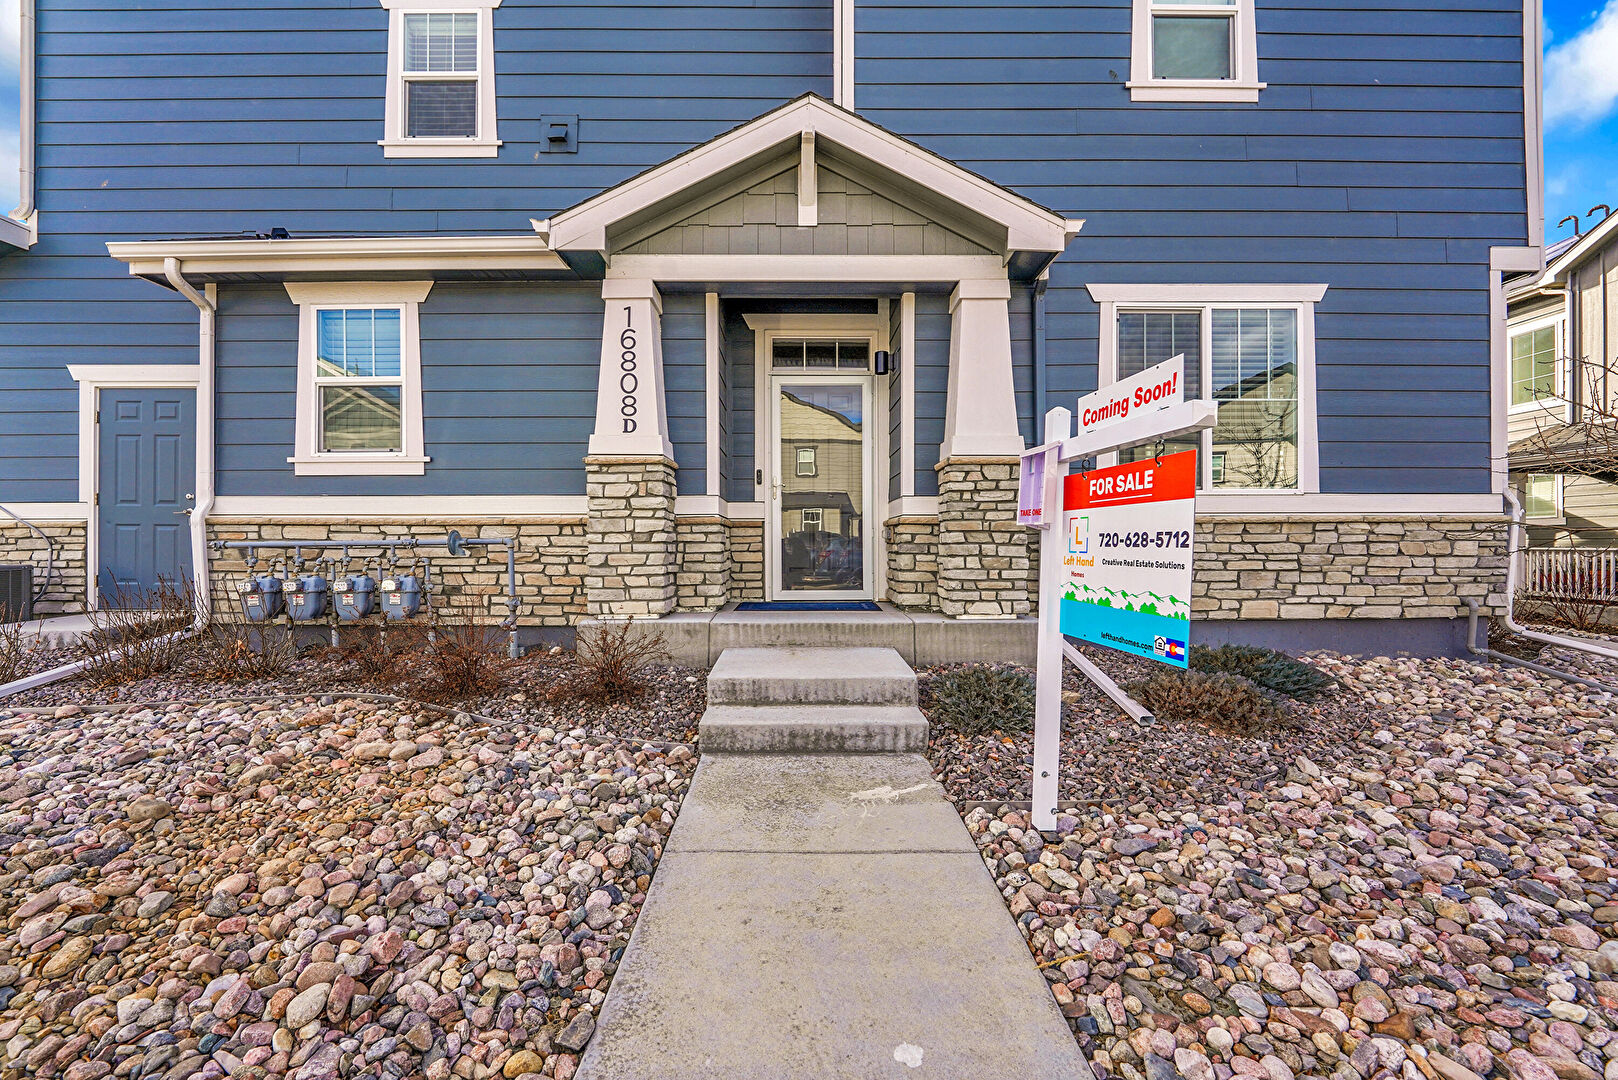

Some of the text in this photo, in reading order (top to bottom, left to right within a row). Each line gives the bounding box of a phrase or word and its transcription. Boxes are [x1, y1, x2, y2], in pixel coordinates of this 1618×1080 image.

[1083, 372, 1178, 427] Coming Soon!
[1089, 470, 1154, 496] FOR SALE
[1032, 508, 1042, 516] ONE
[1099, 531, 1190, 548] 720-628-5712
[1063, 556, 1095, 567] Left Hand
[1102, 558, 1123, 567] Creative
[1135, 560, 1154, 569] Estate
[1154, 561, 1186, 570] Solutions
[1101, 632, 1153, 651] lefthandhomes.com
